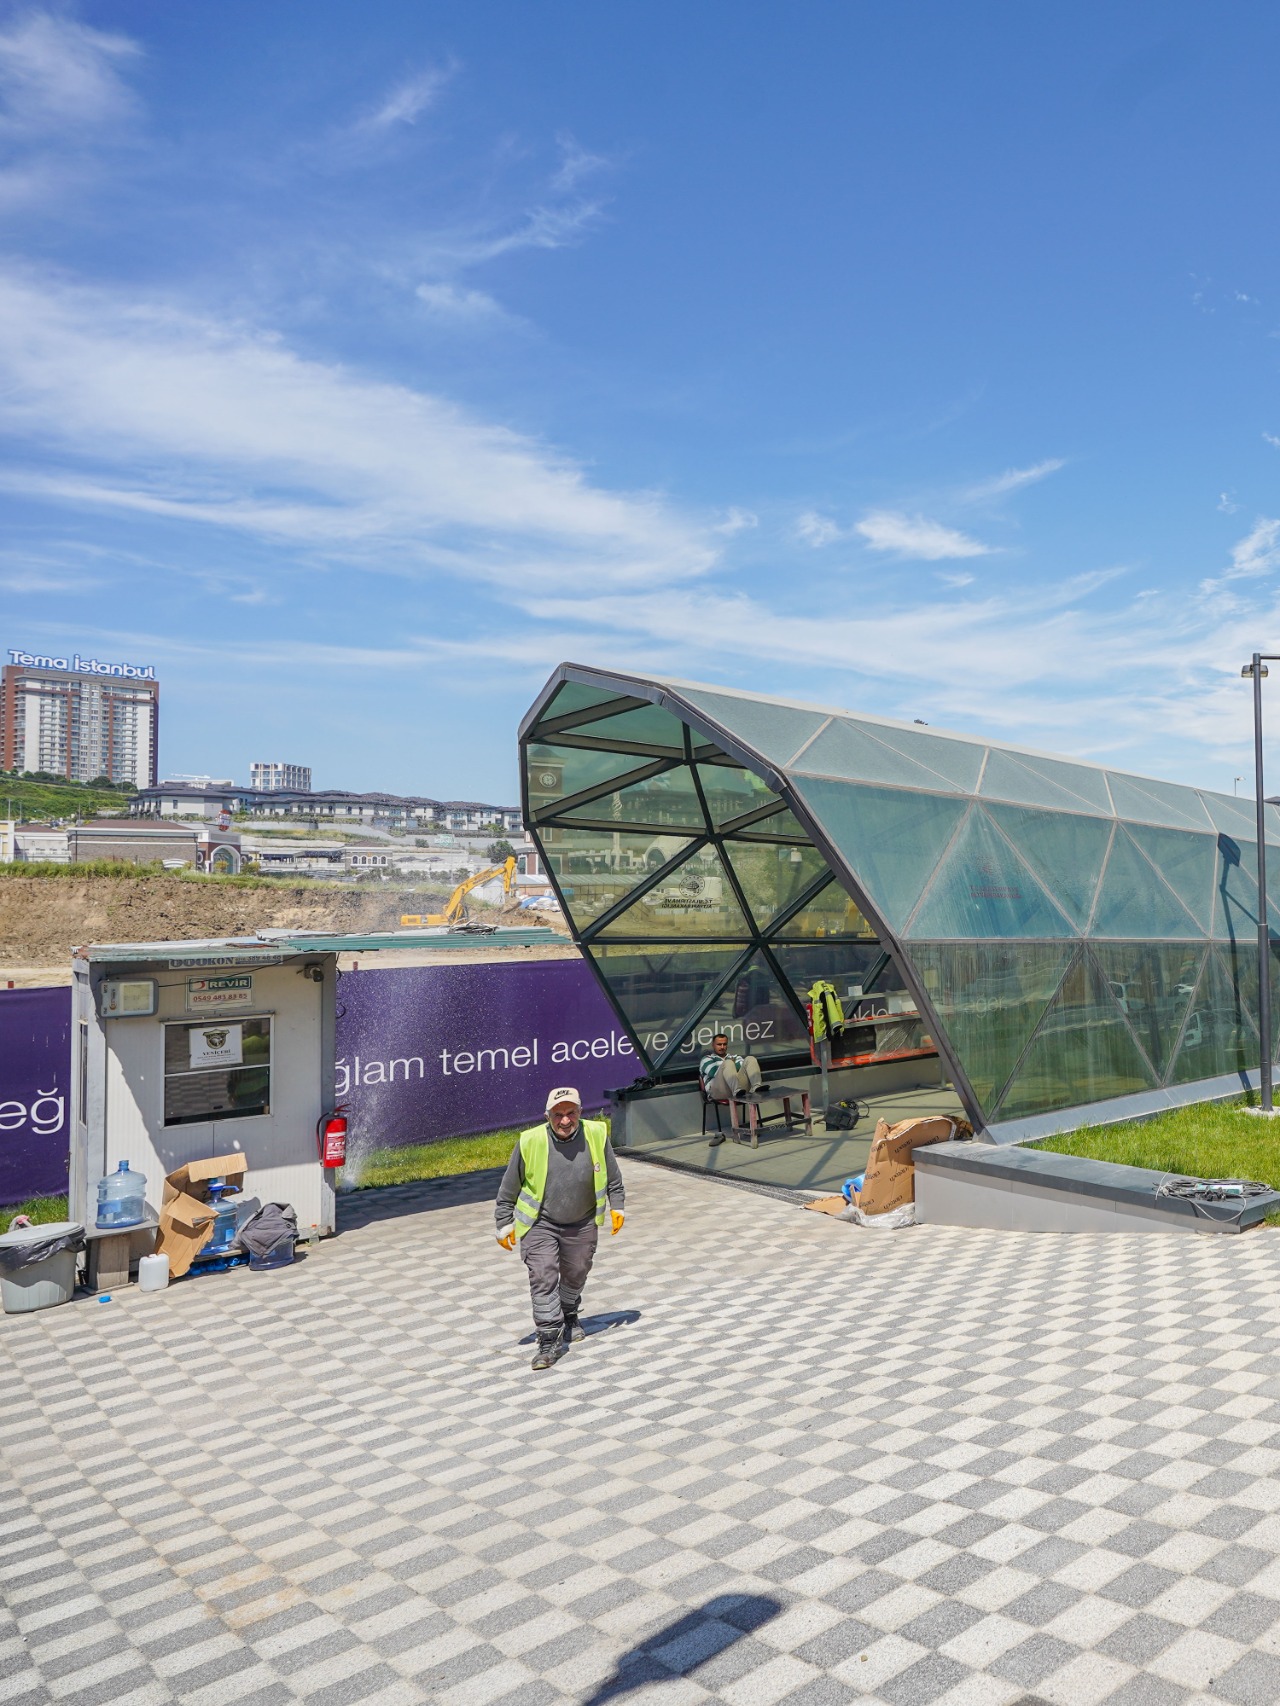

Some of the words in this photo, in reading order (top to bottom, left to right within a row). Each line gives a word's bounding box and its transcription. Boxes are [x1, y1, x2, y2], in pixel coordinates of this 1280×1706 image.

[9, 649, 68, 670] Tema
[74, 654, 155, 680] İstanbul
[209, 979, 248, 988] REVİR
[439, 1038, 538, 1075] temel
